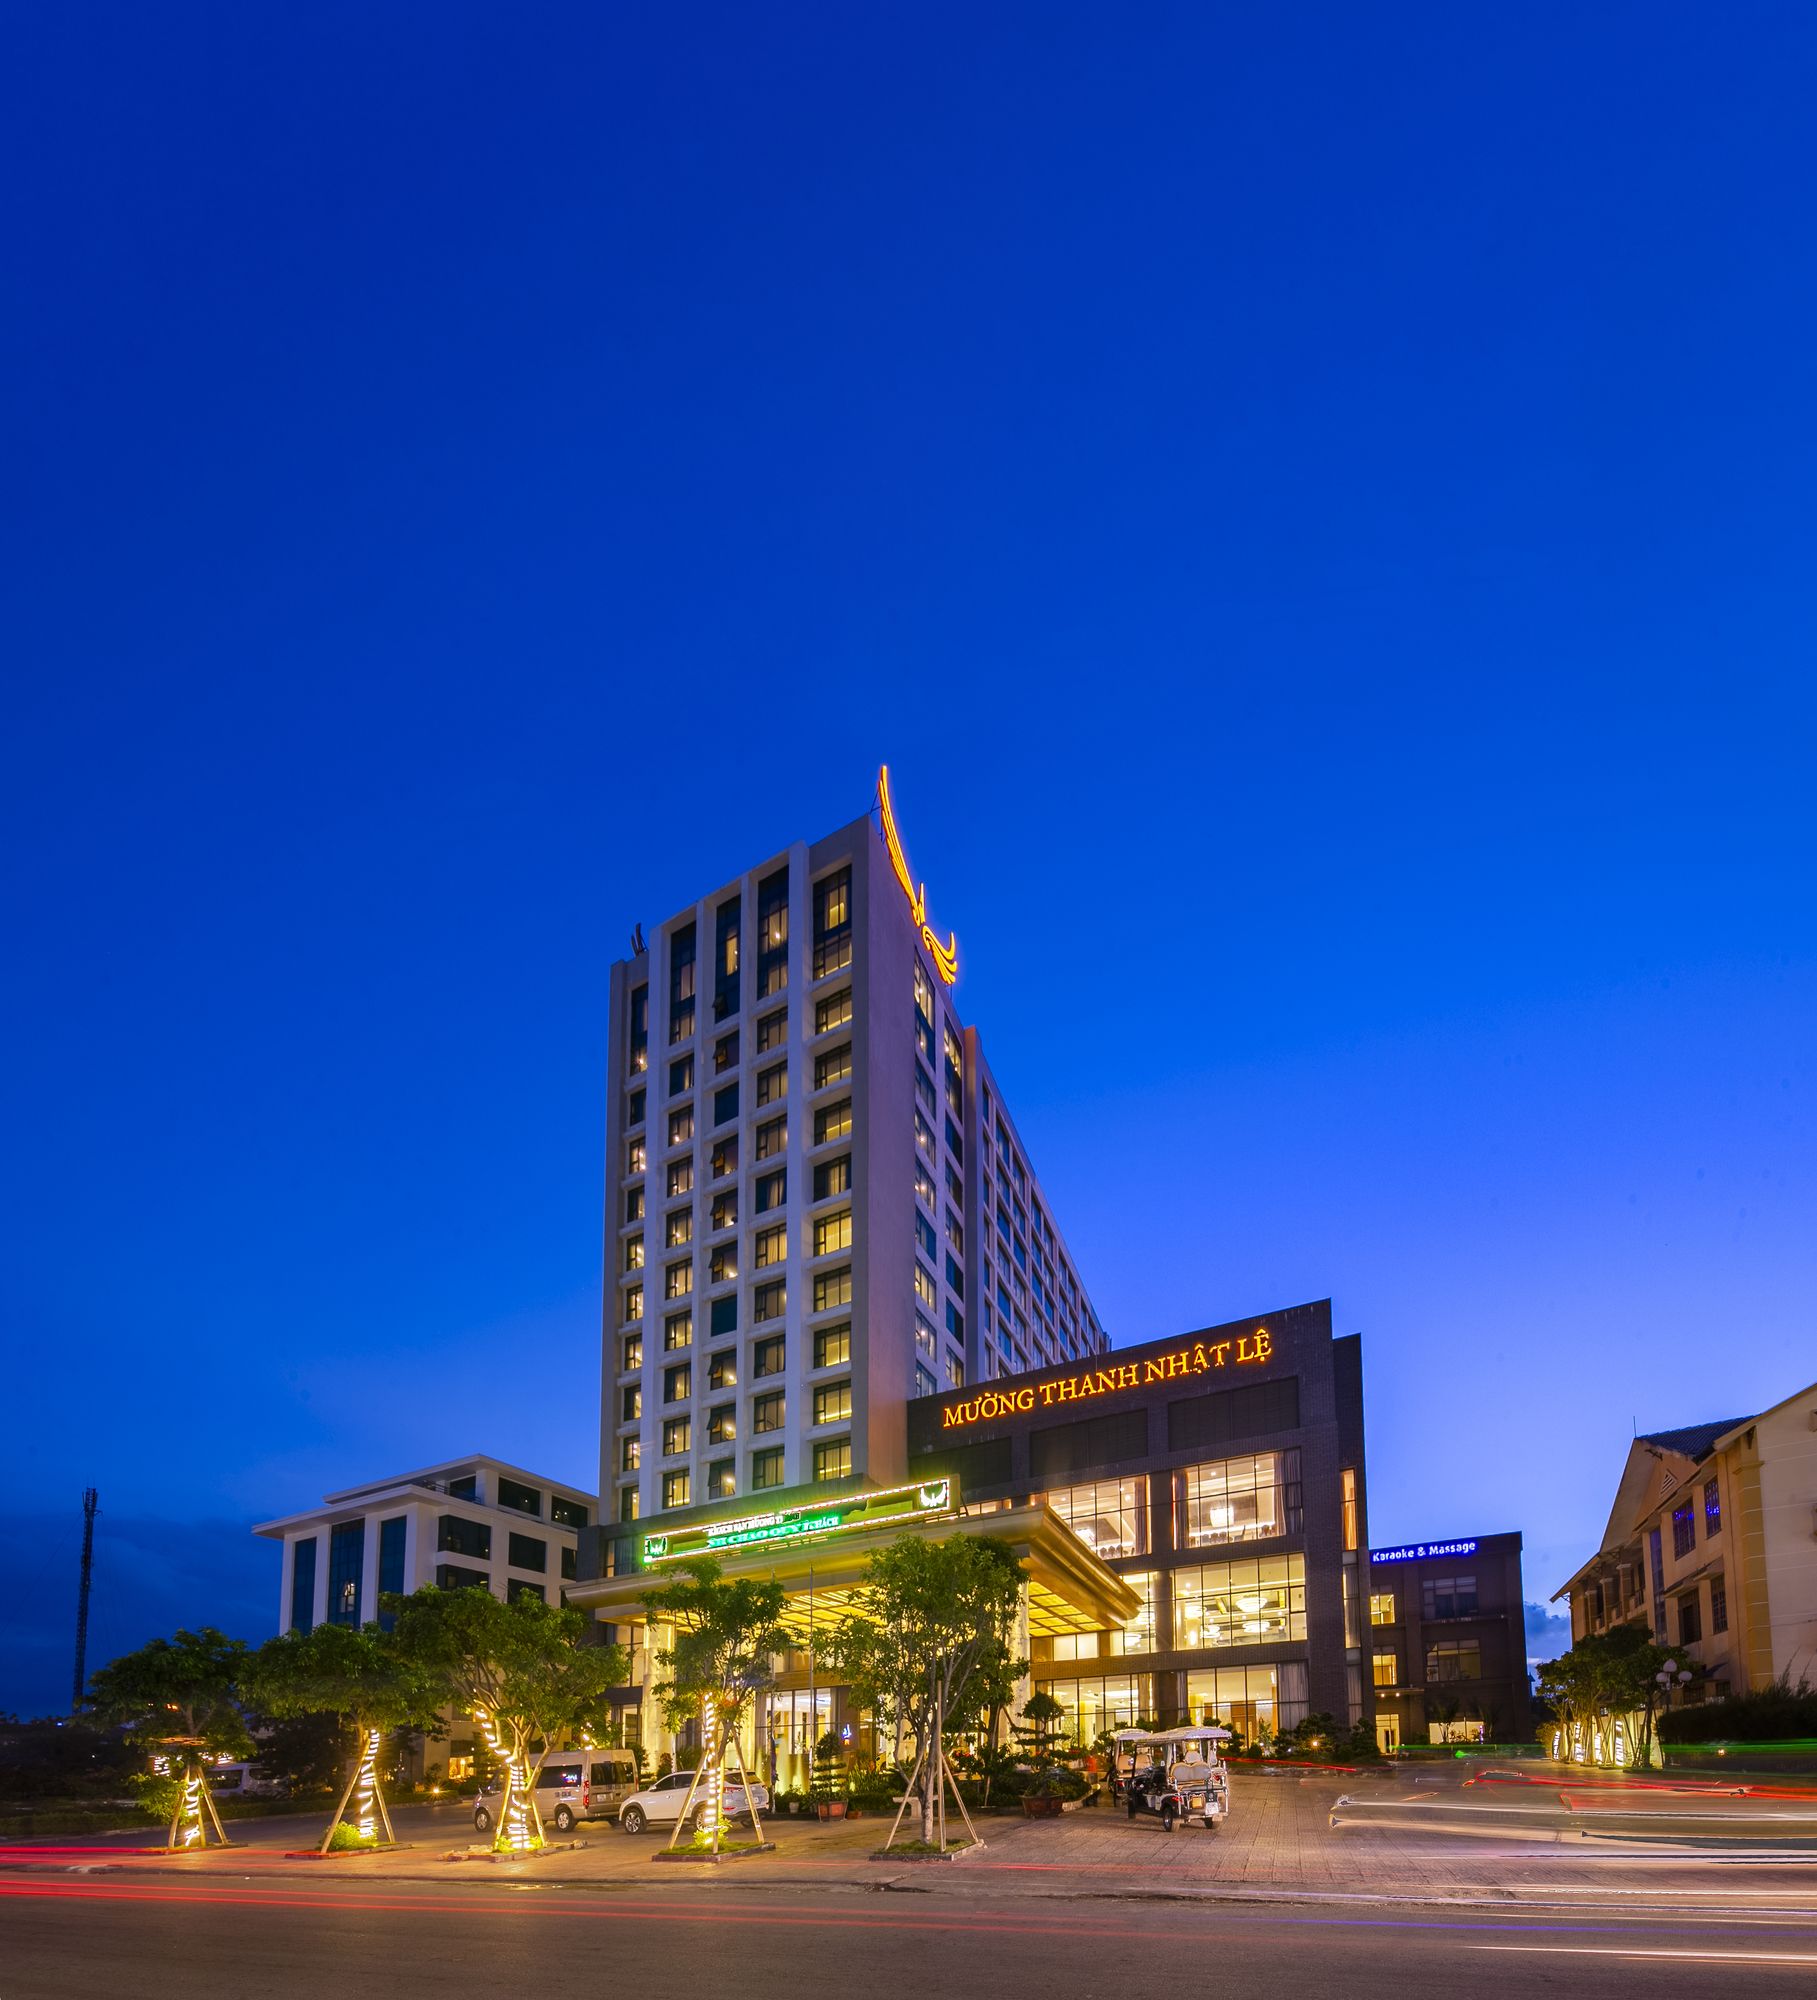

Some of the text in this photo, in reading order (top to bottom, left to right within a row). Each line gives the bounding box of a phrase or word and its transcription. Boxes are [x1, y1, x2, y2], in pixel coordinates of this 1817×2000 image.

[944, 1328, 1272, 1427] MƯỜNG THANH NHẬT LỆ
[1372, 1542, 1476, 1562] Karaoke & Massage
